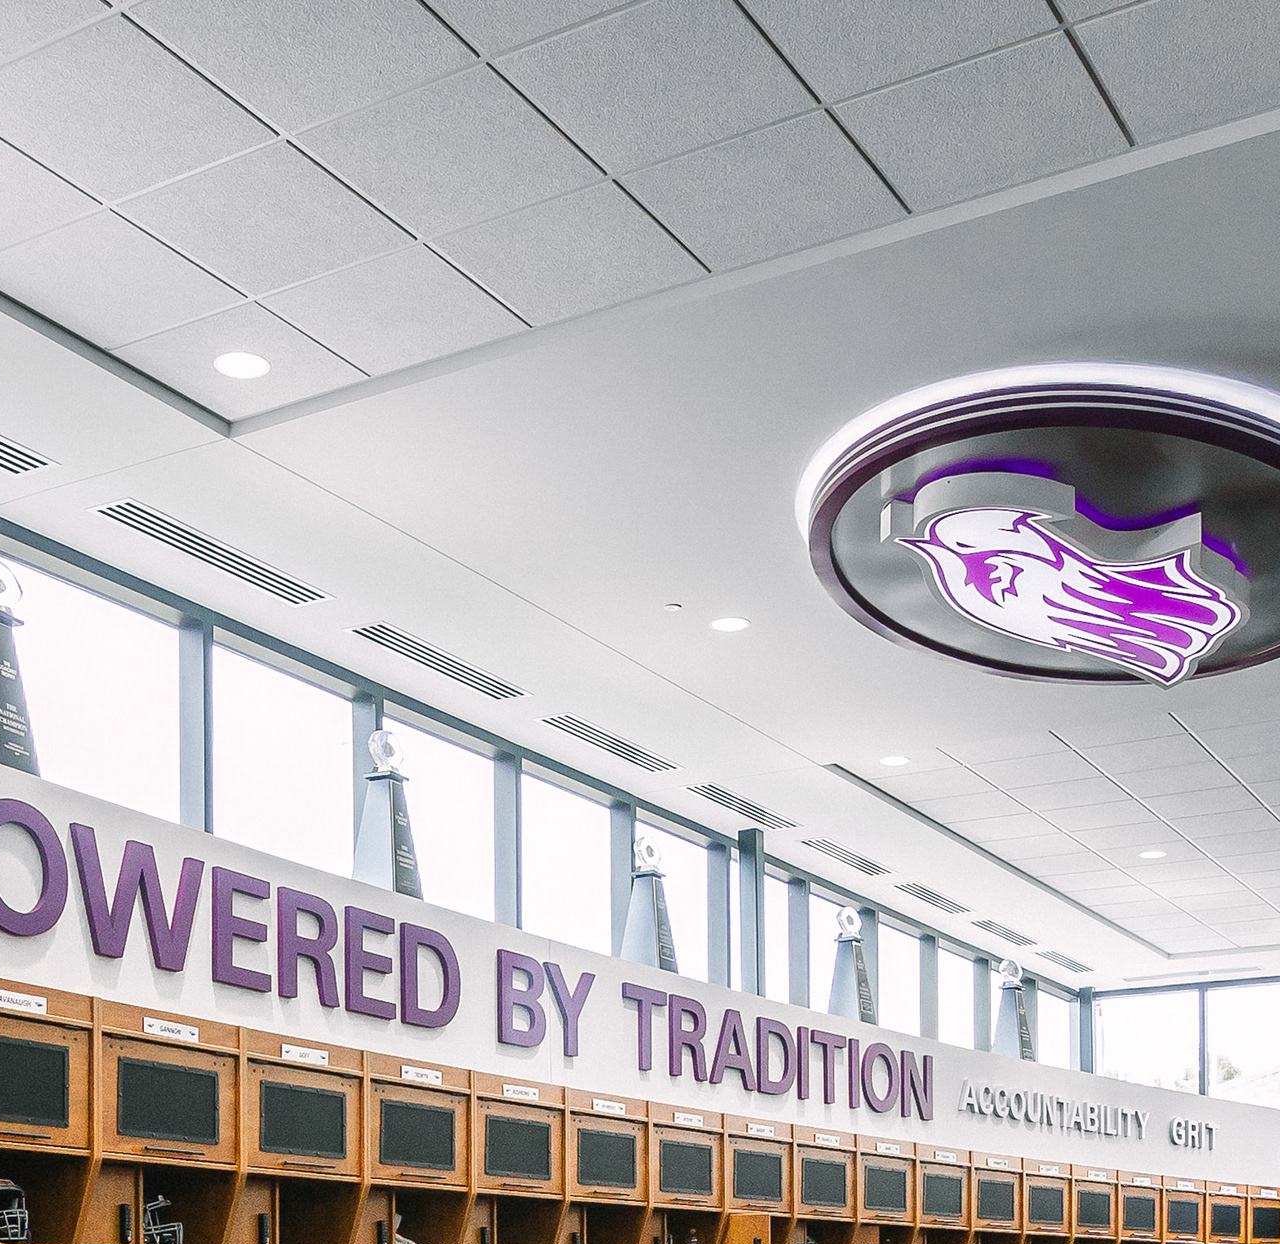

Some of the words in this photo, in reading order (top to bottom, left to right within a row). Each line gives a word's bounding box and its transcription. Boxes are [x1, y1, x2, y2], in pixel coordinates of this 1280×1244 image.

[496, 947, 596, 1058] BY
[621, 981, 934, 1122] TRADITION
[959, 1079, 1150, 1140] ACCOUNTABILITY
[1170, 1115, 1221, 1151] GRIT
